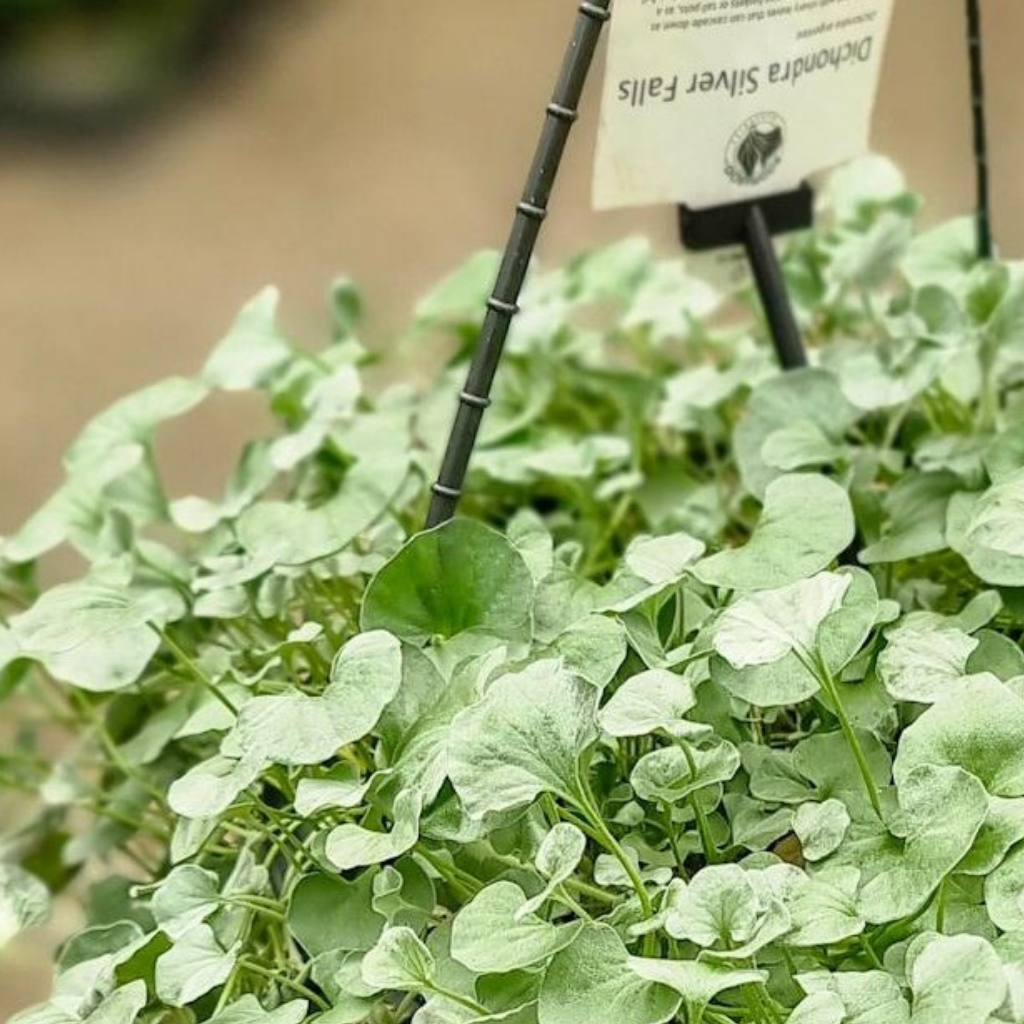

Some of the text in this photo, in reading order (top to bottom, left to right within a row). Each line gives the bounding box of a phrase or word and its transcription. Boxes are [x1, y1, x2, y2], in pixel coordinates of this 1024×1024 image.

[692, 16, 728, 27] cascade
[730, 14, 747, 22] can
[748, 11, 765, 22] that
[663, 20, 689, 31] down
[618, 36, 873, 107] Dichondra Silver Falls
